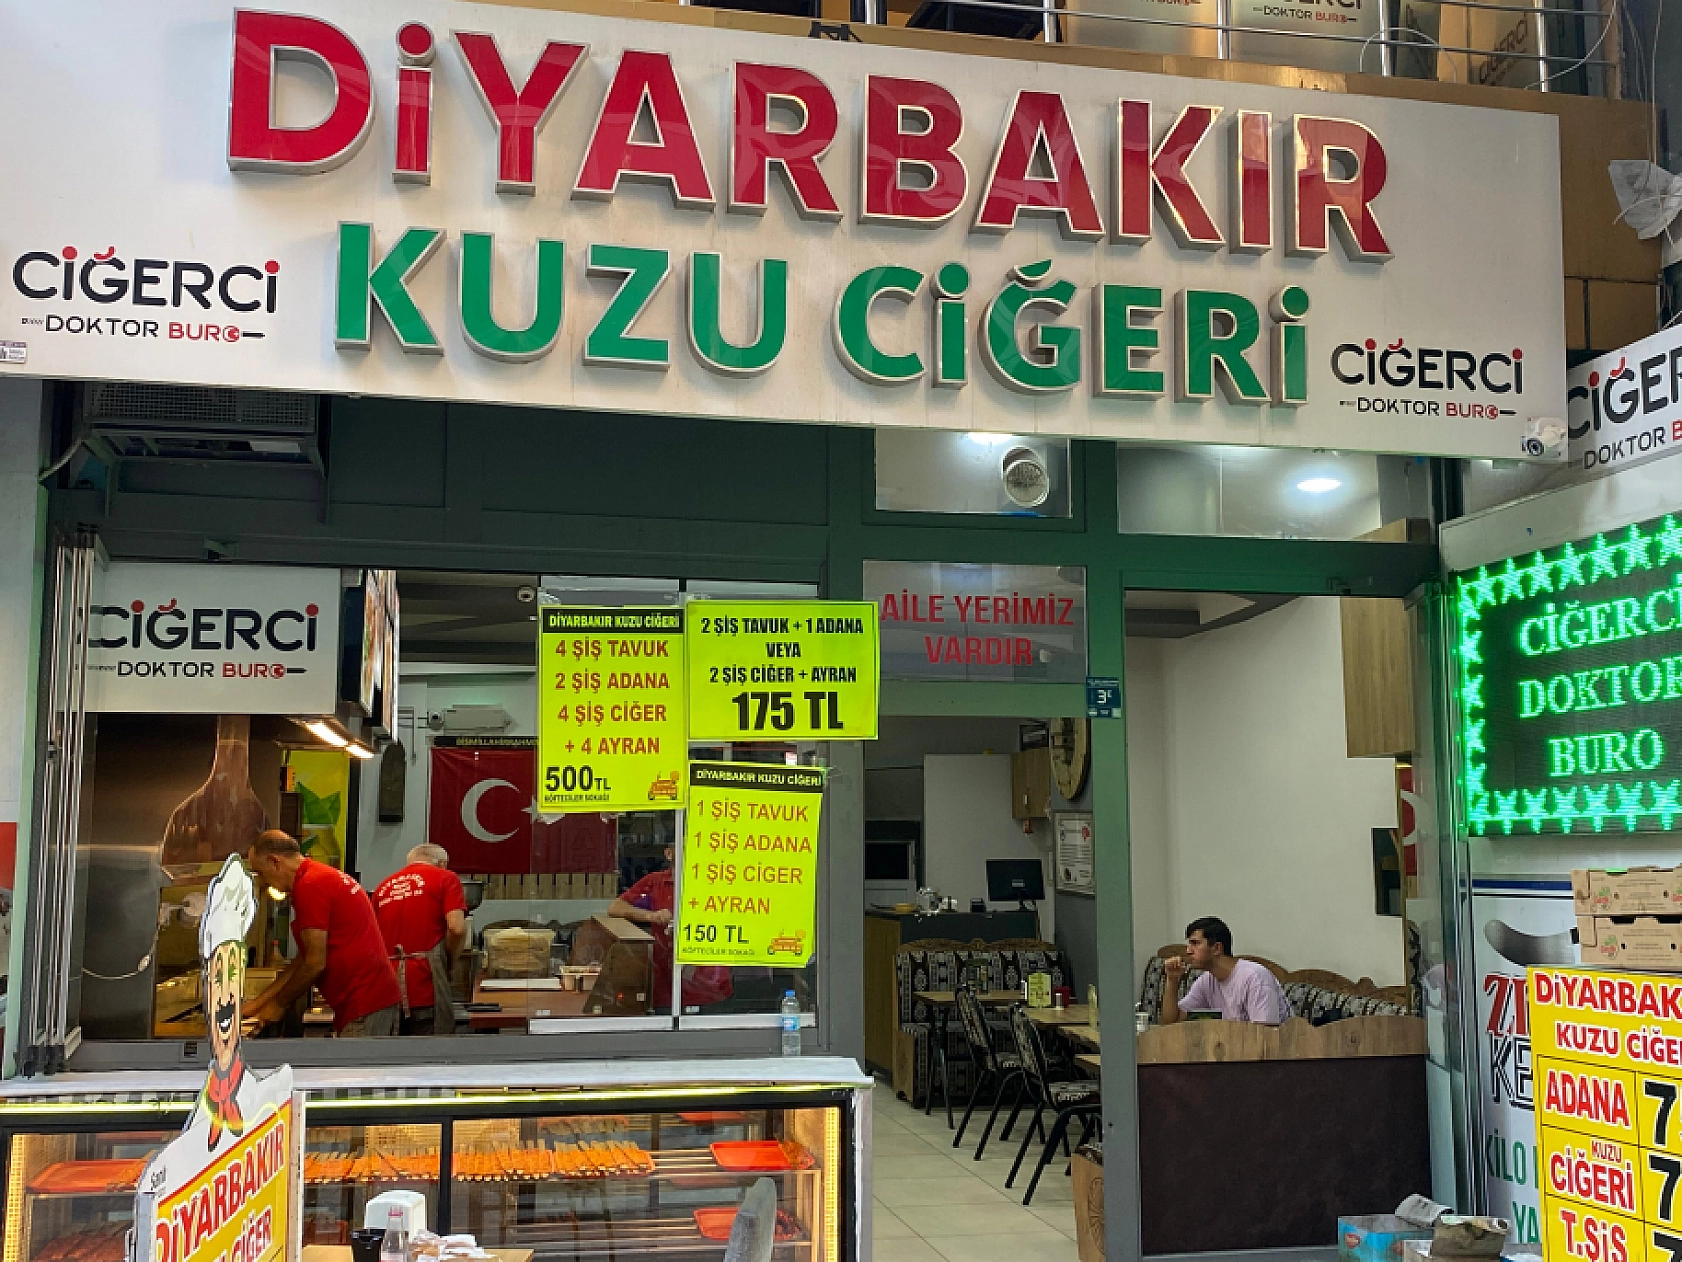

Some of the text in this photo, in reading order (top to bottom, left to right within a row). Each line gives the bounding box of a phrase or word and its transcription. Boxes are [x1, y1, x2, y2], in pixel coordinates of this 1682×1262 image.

[1264, 4, 1313, 20] DOKTOR
[227, 7, 1395, 262] DİYARBAKIR
[12, 245, 281, 314] CİĞERCİ
[45, 313, 159, 338] DOKTOR
[335, 220, 1310, 408] KUZU CİĞERİ
[1331, 338, 1523, 394] CİĞERCİ
[1357, 397, 1440, 417] DOKTOR
[1584, 426, 1666, 470] DOKTOR
[880, 588, 1074, 627] AİLE YERİMİZ
[78, 598, 319, 651] CİĞERCİ
[701, 617, 711, 634] 2
[713, 614, 739, 637] ŞİŞ
[741, 617, 790, 634] TAVUK
[805, 618, 813, 634] 1
[816, 617, 864, 634] ADANA
[555, 636, 669, 662] 4 ŞİŞ TAVUK
[765, 641, 802, 658] VEYA
[925, 635, 1033, 667] VARDIR
[117, 661, 215, 678] DOKTOR
[555, 668, 670, 694] 2 ŞİŞ ADANA
[709, 667, 719, 683] 2
[722, 664, 747, 686] ŞİŞ
[811, 667, 857, 684] AYRAN
[557, 700, 667, 727] 4 ŞİŞ CİĞER
[731, 691, 845, 731] 175 TL
[581, 738, 592, 755] 4
[597, 737, 660, 755] AYRAN
[1549, 729, 1665, 777] BURO
[696, 797, 809, 822] 1 ŞİŞ TAVUK
[694, 828, 812, 854] 1 ŞİŞ ADANA
[691, 863, 699, 880] 1
[706, 860, 737, 885] ŞİŞ
[704, 896, 770, 915] AYRAN
[683, 923, 750, 944] 150 TL
[1556, 1021, 1682, 1066] KUZU CİĞE
[1545, 1069, 1682, 1147] ADANA 7
[1591, 1139, 1622, 1164] KUZU
[1550, 1146, 1636, 1212] CİĞERİ
